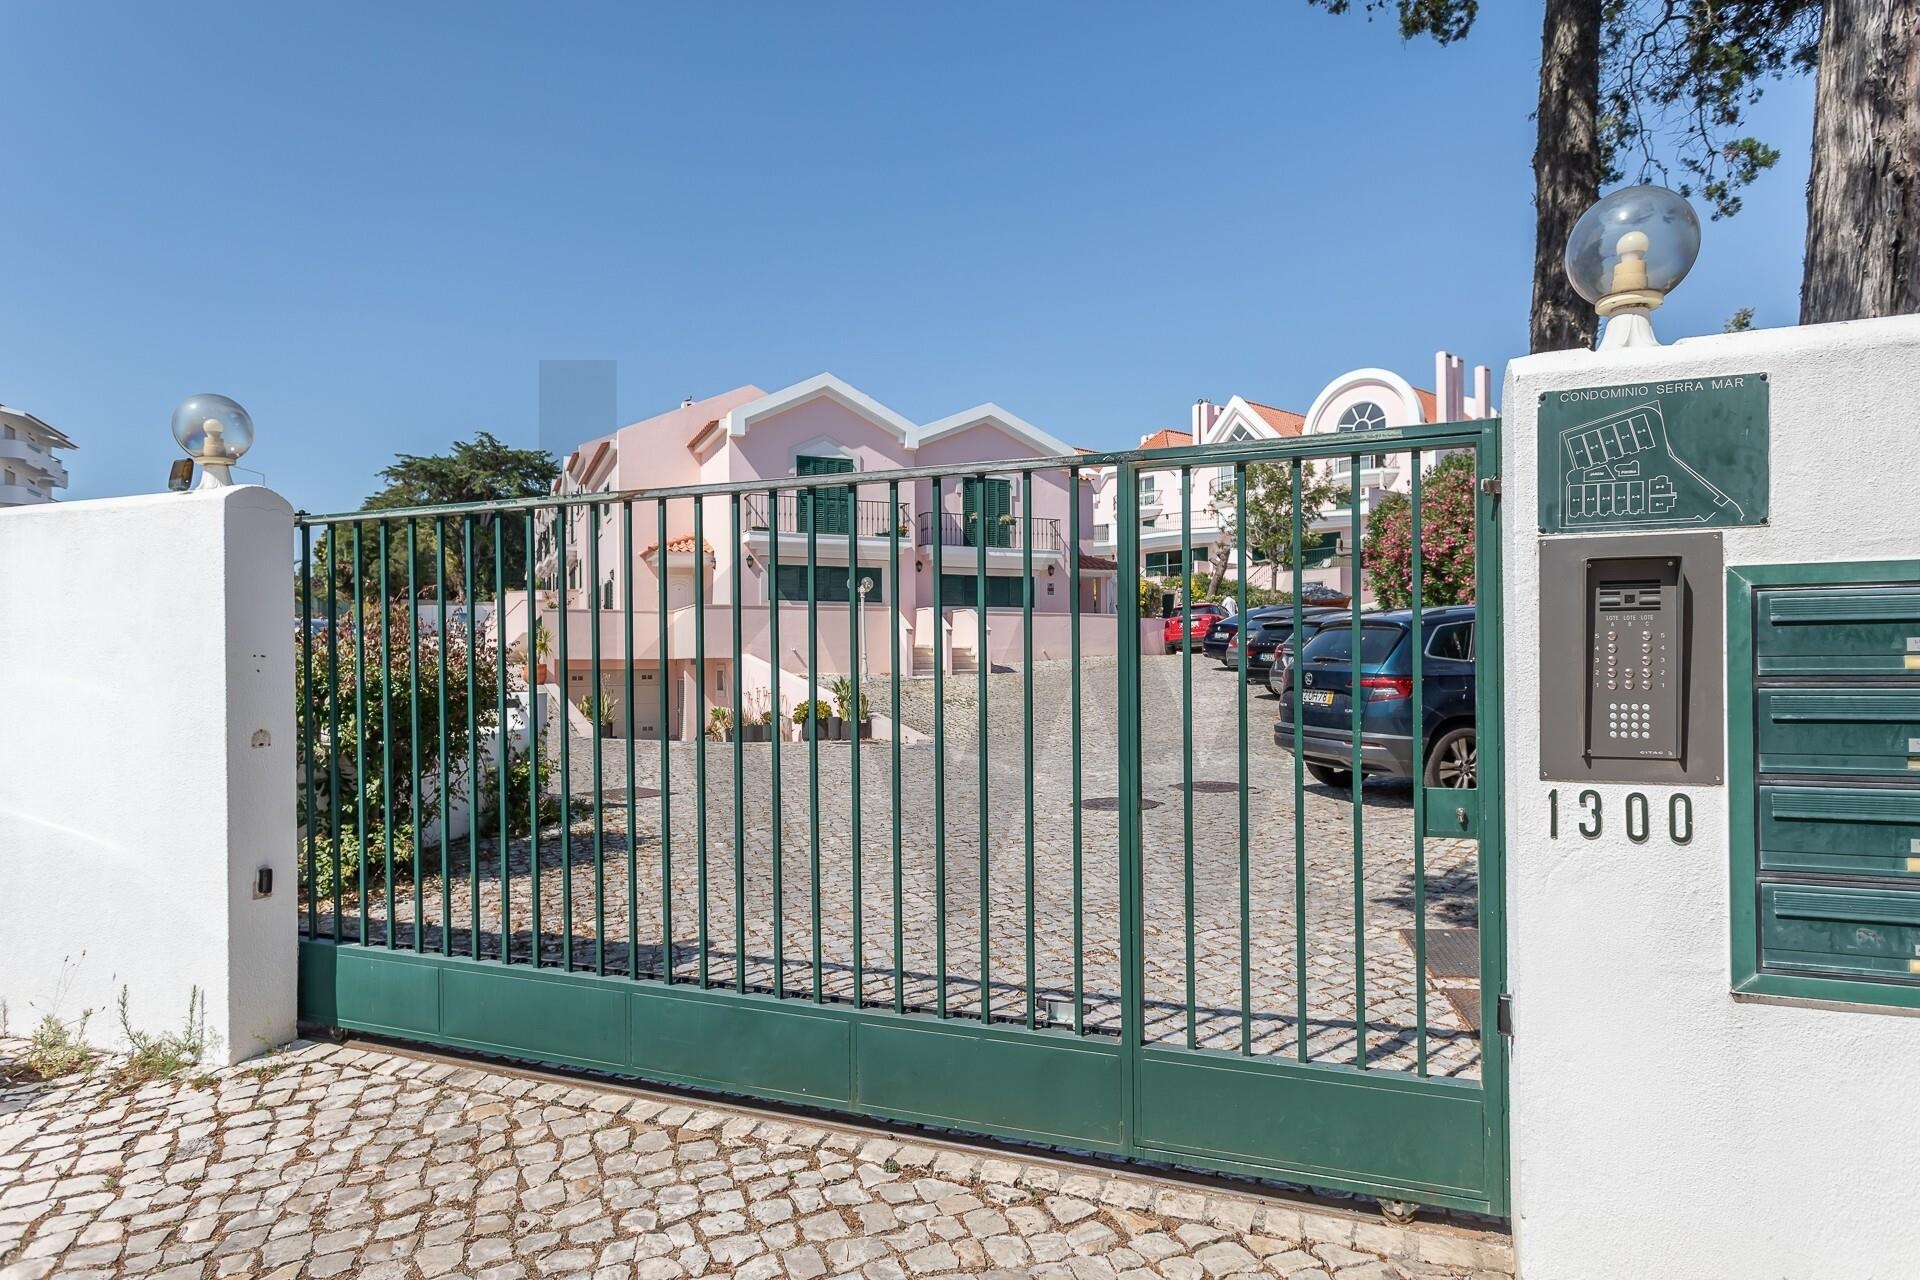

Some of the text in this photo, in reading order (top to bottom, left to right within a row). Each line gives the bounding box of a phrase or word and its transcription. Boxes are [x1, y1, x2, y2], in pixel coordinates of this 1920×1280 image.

[1559, 377, 1744, 403] CONDOMINIO SERRA MAR
[1548, 788, 1693, 846] 1300
